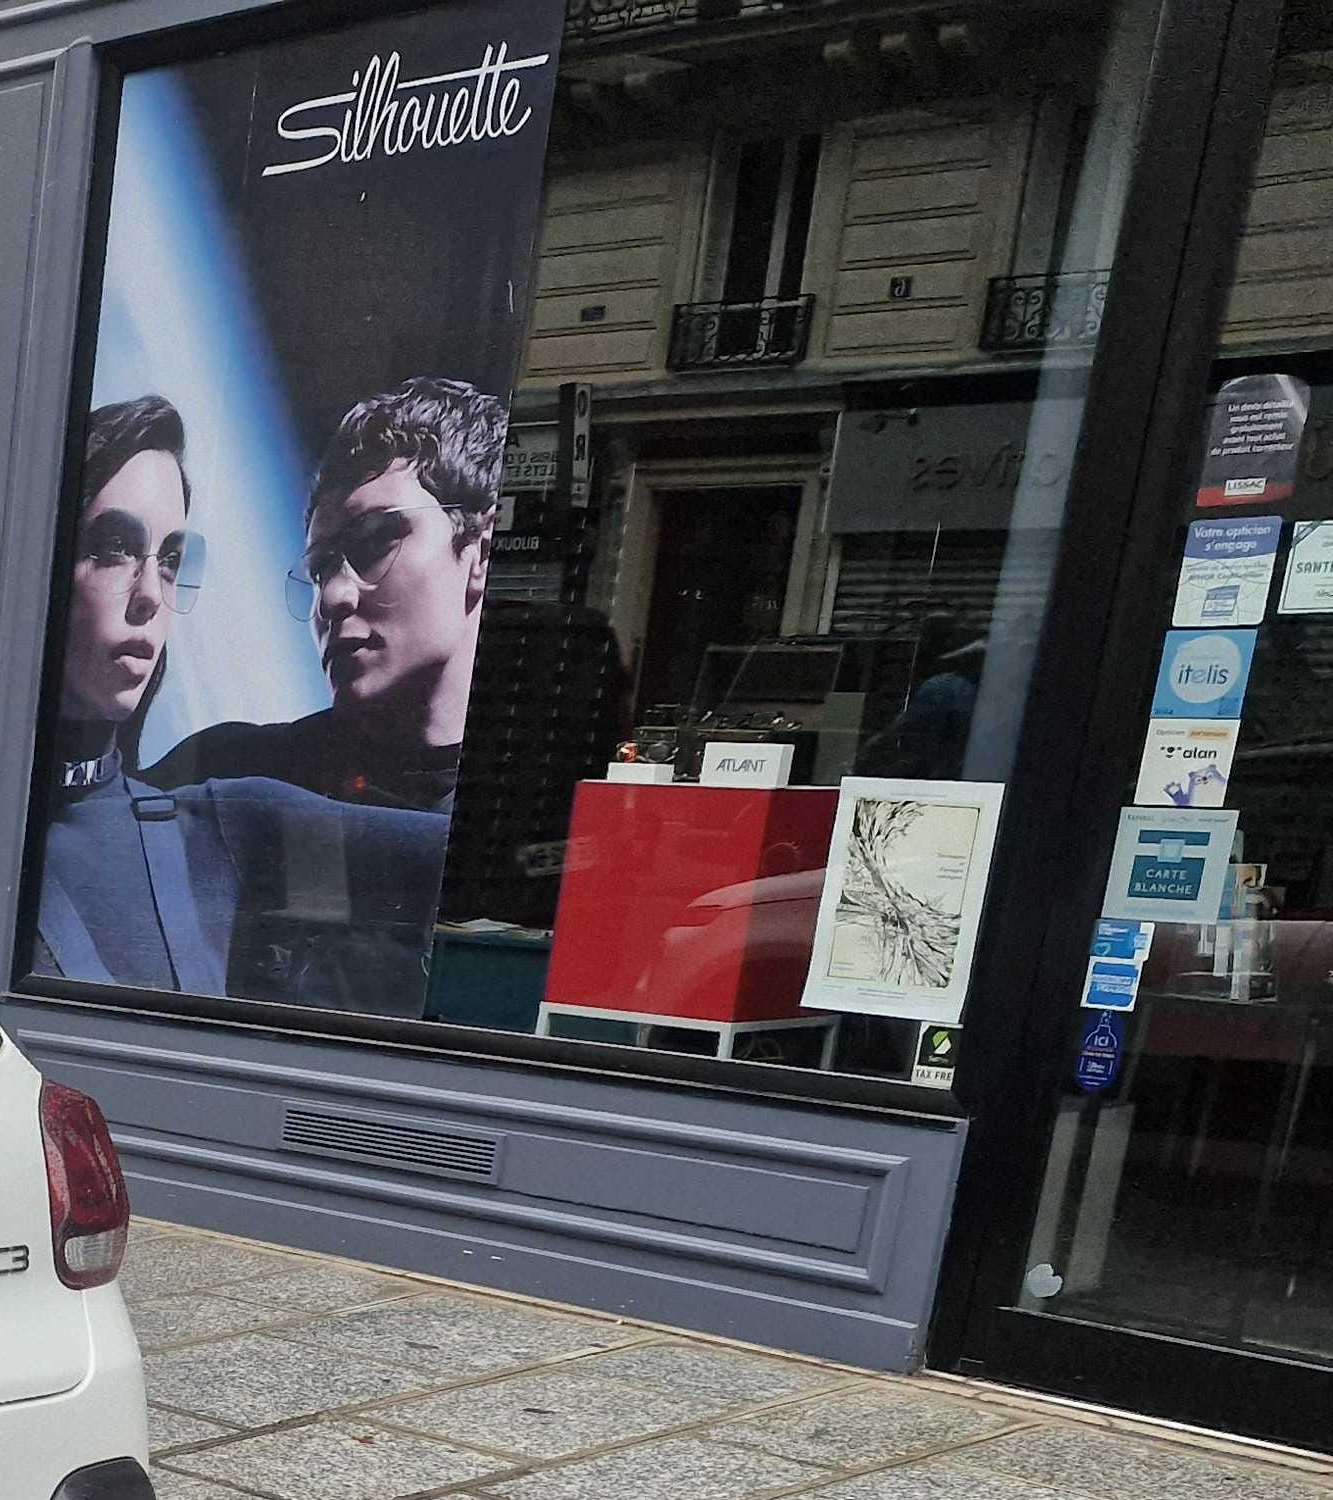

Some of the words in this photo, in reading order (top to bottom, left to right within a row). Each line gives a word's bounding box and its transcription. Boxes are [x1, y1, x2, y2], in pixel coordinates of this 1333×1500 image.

[262, 41, 550, 177] Silhouette
[1227, 481, 1263, 490] LISSAC
[1194, 527, 1224, 538] Votre
[1226, 525, 1271, 538] opticien
[1204, 540, 1258, 553] s'engage
[1177, 664, 1229, 685] itelis
[1183, 747, 1217, 759] alan
[715, 759, 767, 772] ATLANT
[1145, 868, 1188, 881] CARTE
[1133, 882, 1193, 896] BLANCHE
